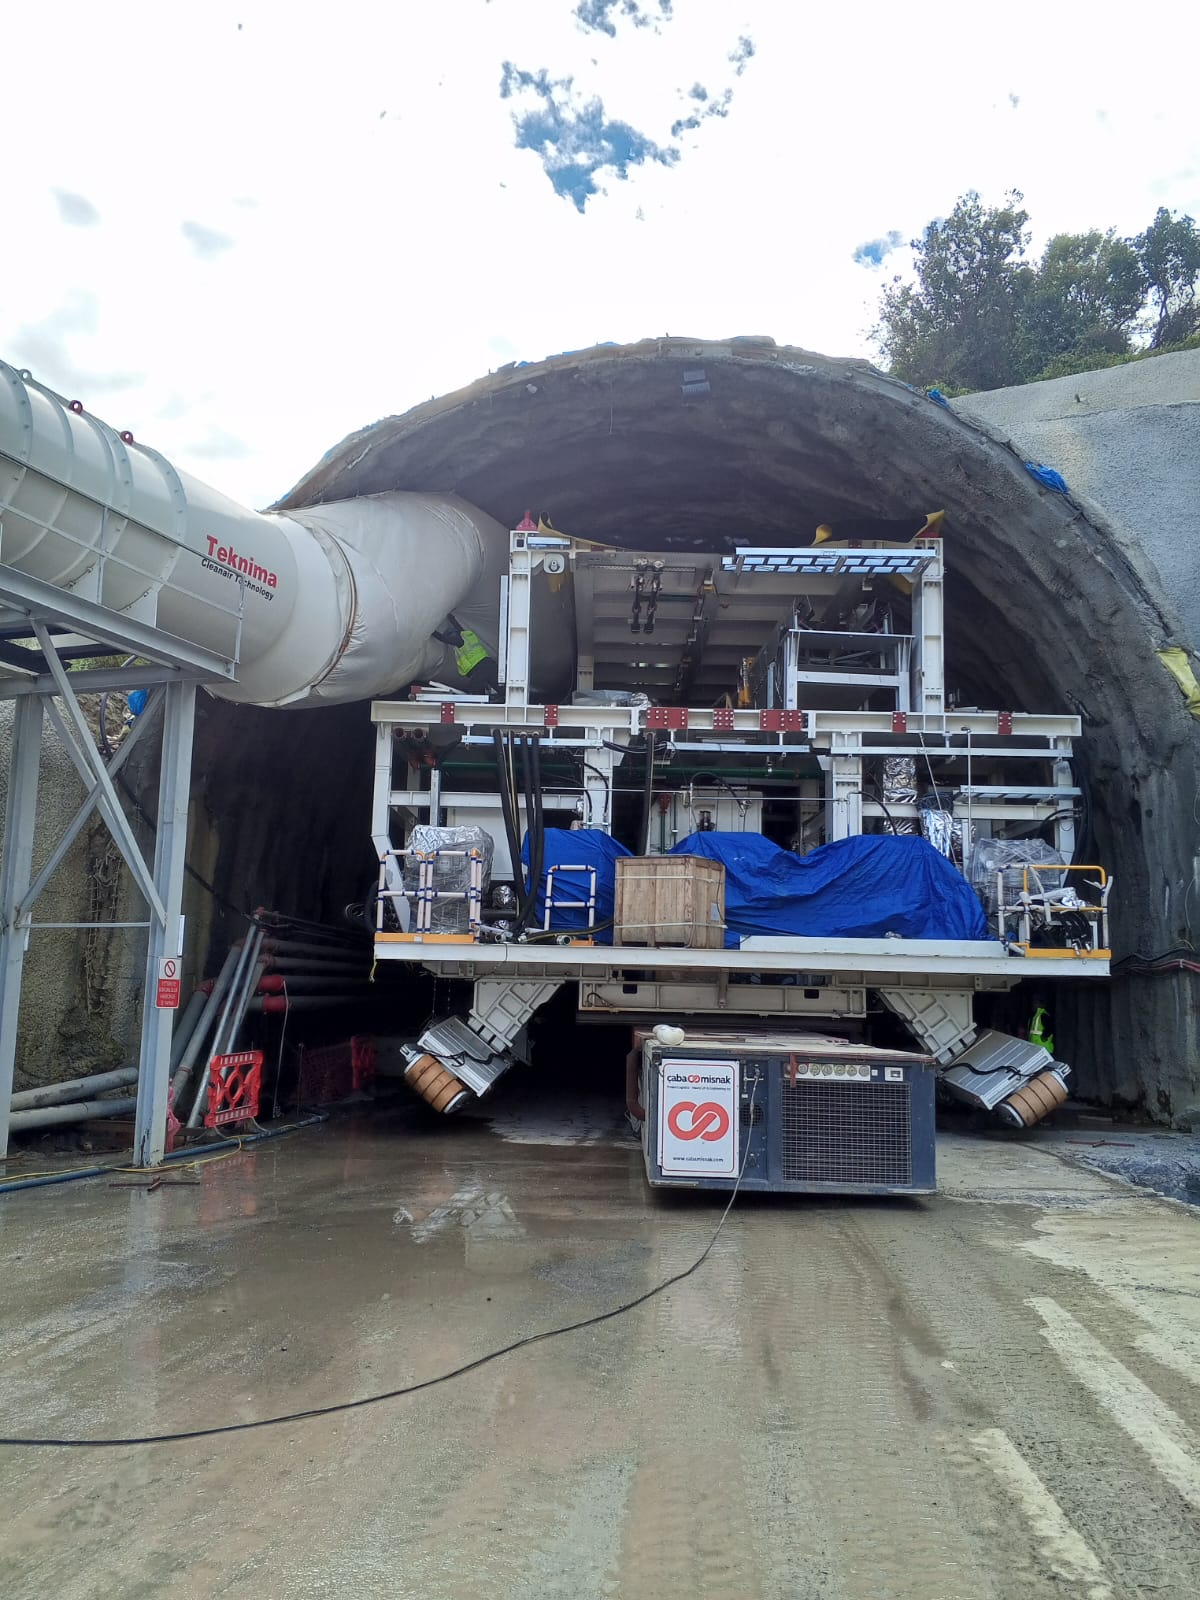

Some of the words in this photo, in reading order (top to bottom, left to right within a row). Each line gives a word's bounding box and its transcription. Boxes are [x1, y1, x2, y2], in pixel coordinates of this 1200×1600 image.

[201, 558, 234, 580] Cleanair
[206, 534, 277, 588] Teknima
[667, 1074, 687, 1083] caba
[700, 1075, 732, 1084] misnak
